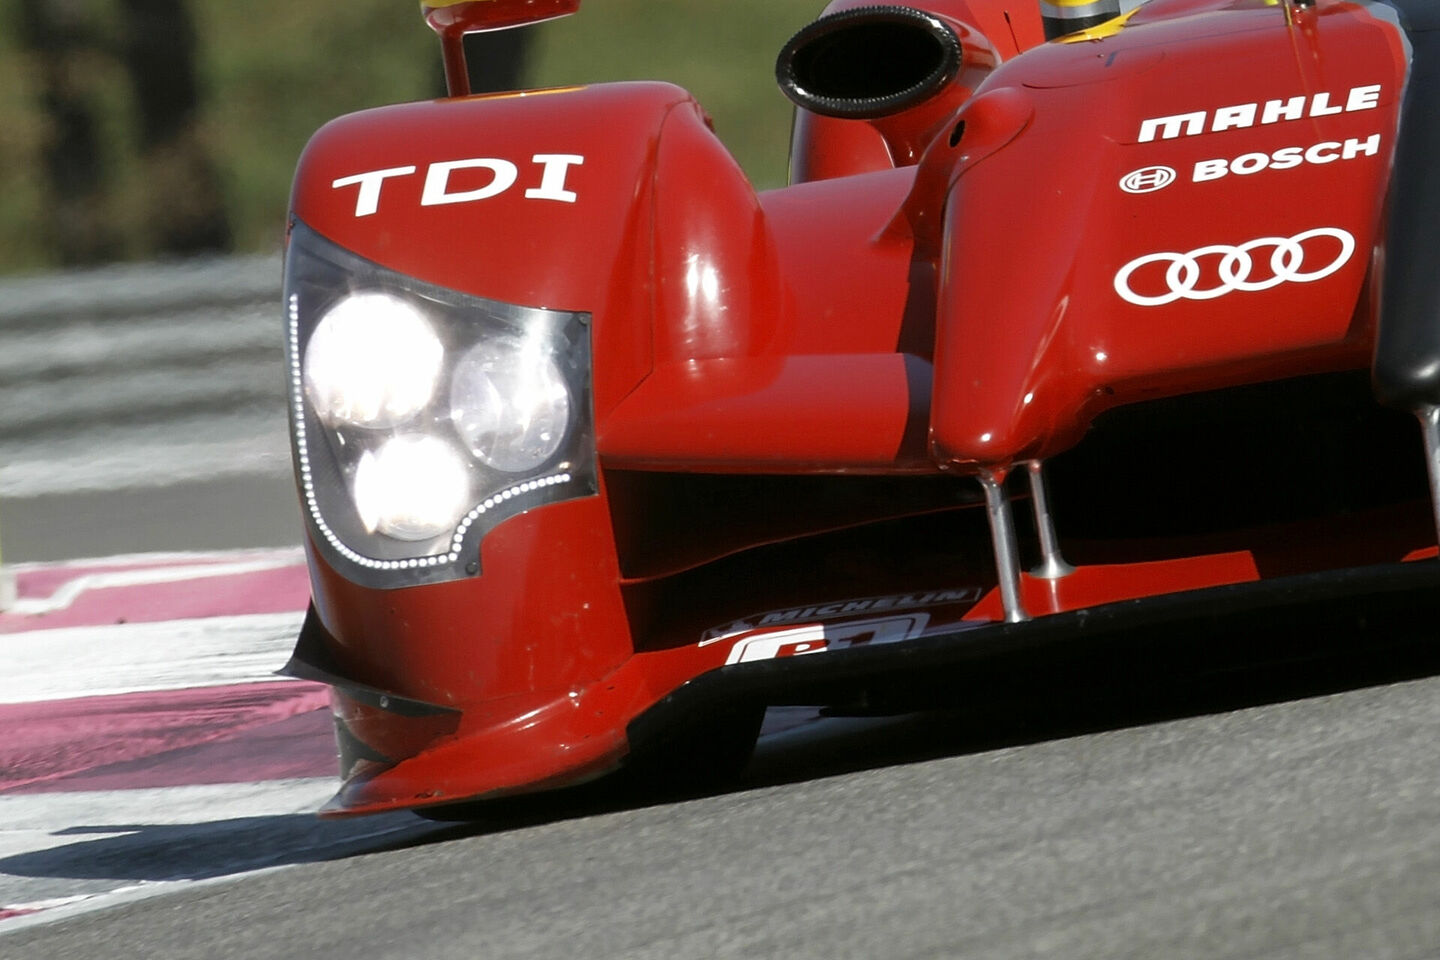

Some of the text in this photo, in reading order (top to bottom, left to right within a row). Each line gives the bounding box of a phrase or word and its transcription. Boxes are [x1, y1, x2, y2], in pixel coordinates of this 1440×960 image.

[1137, 84, 1382, 143] MAHLE
[1191, 133, 1381, 183] BOSCH
[332, 154, 585, 218] TDI
[758, 589, 970, 625] MICHELIN
